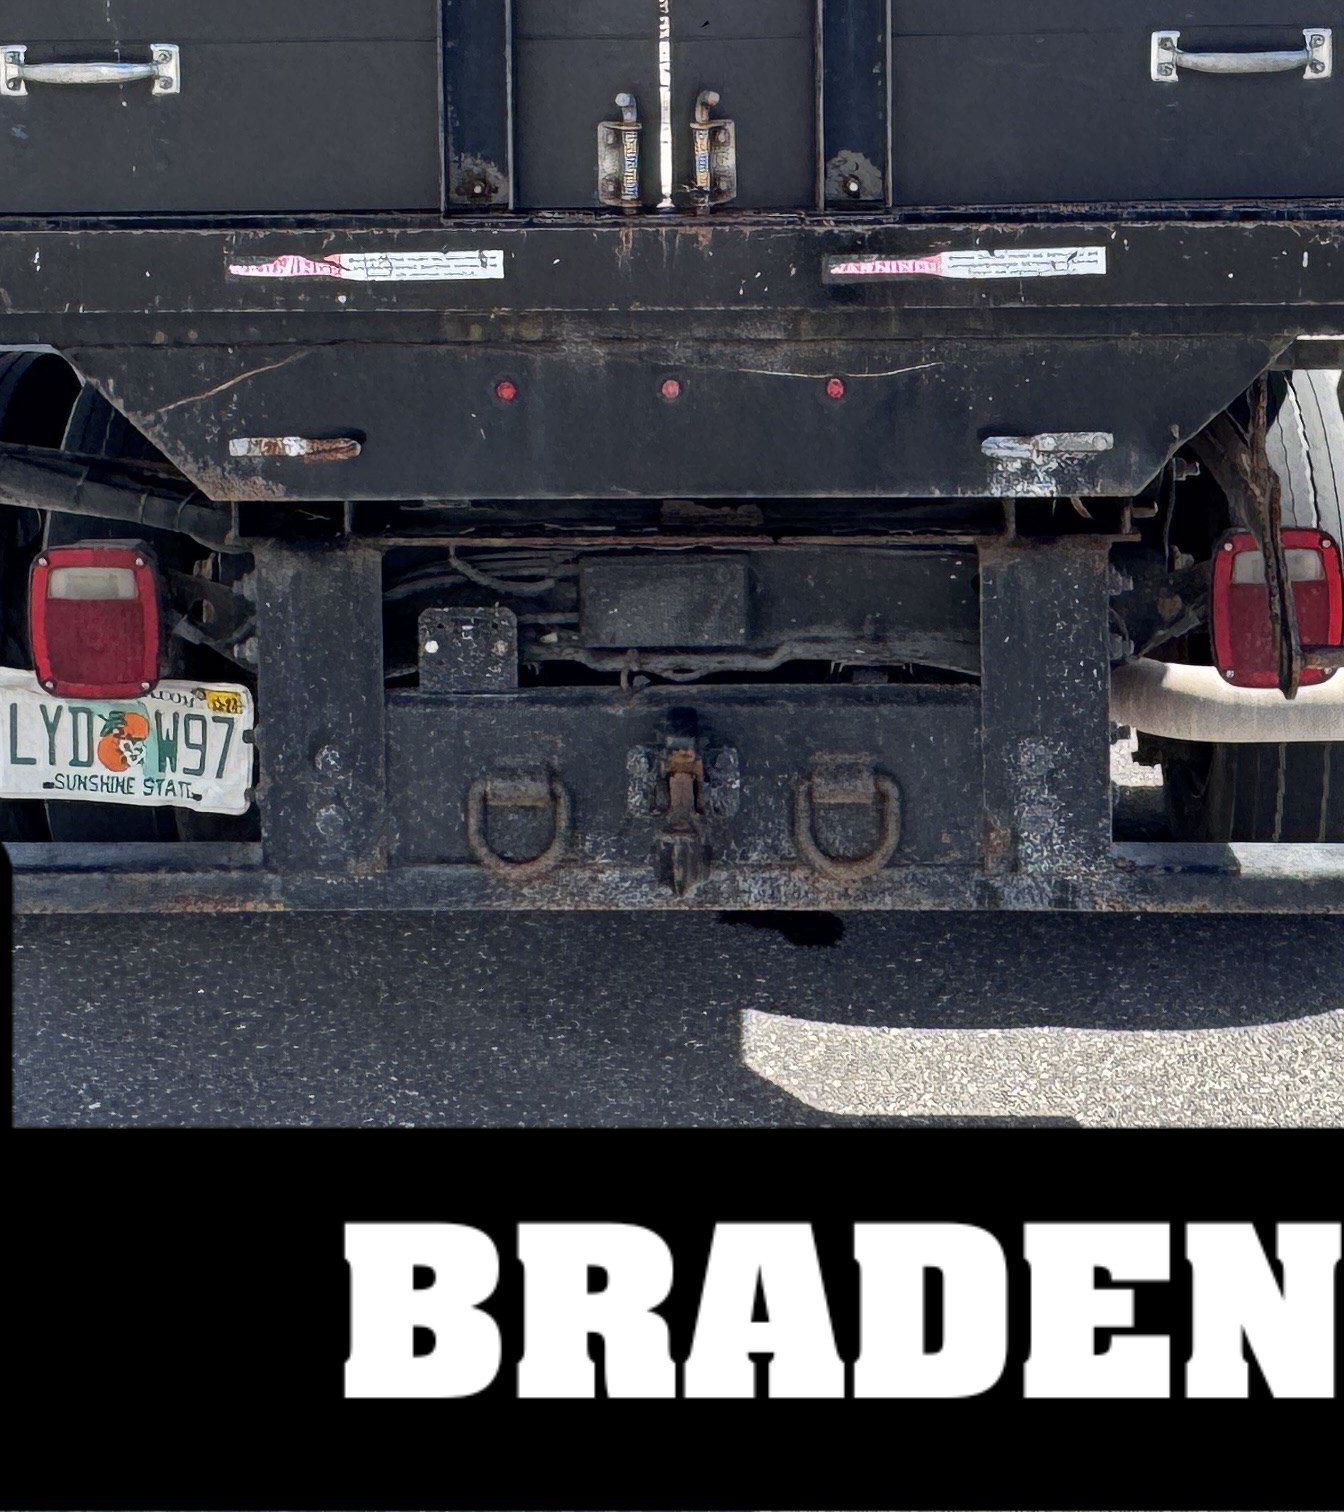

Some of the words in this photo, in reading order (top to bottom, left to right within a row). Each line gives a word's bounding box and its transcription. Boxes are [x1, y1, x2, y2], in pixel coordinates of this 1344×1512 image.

[9, 702, 94, 768] LYD
[155, 711, 236, 779] W97
[54, 774, 135, 794] SUNSHINE
